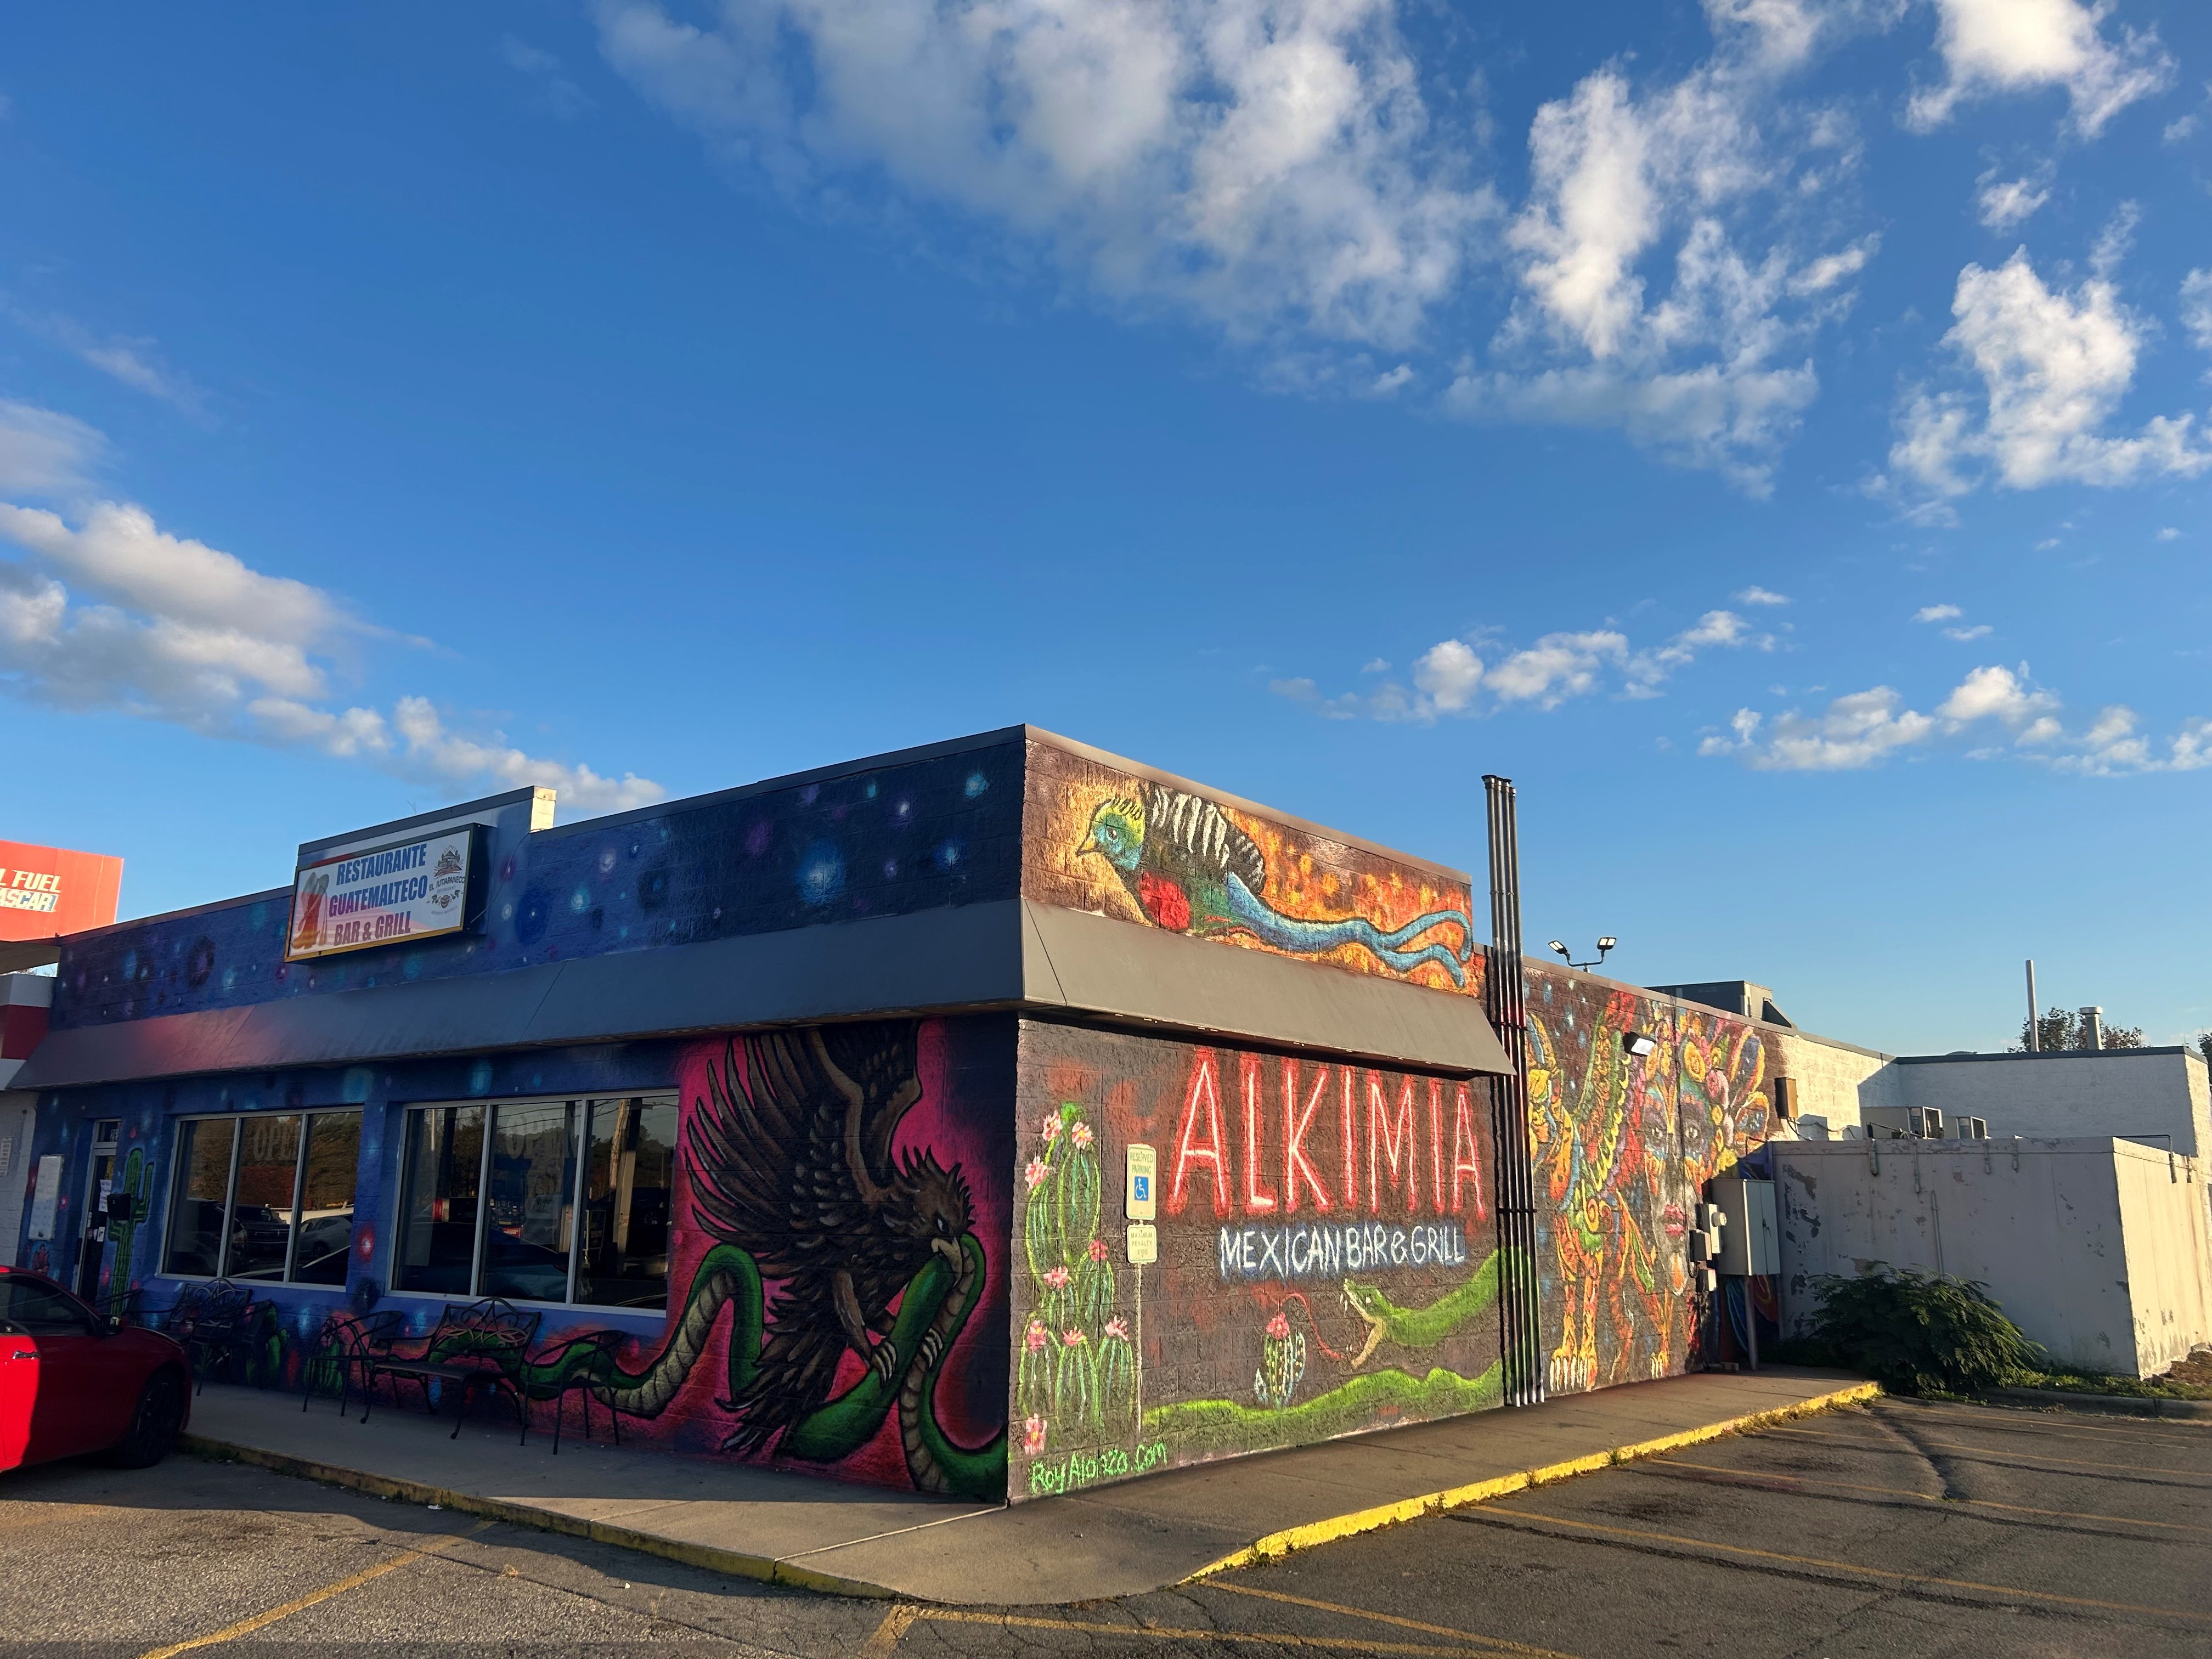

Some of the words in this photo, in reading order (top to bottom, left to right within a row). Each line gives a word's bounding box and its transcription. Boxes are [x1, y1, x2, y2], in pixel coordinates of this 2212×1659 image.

[11, 870, 61, 893] FUEL
[336, 844, 427, 885] RESTAURANTE
[329, 875, 428, 917] GUATEMALTECO
[333, 921, 360, 946] BAR
[362, 922, 372, 940] &
[375, 911, 411, 939] GRILL
[1167, 1047, 1487, 1220] ALKIMIA
[1130, 1152, 1153, 1163] RESERVED
[1131, 1164, 1151, 1175] PARKING
[1220, 1226, 1341, 1279] MEXICAN
[1346, 1221, 1388, 1268] BAR
[1410, 1225, 1465, 1265] GRILL
